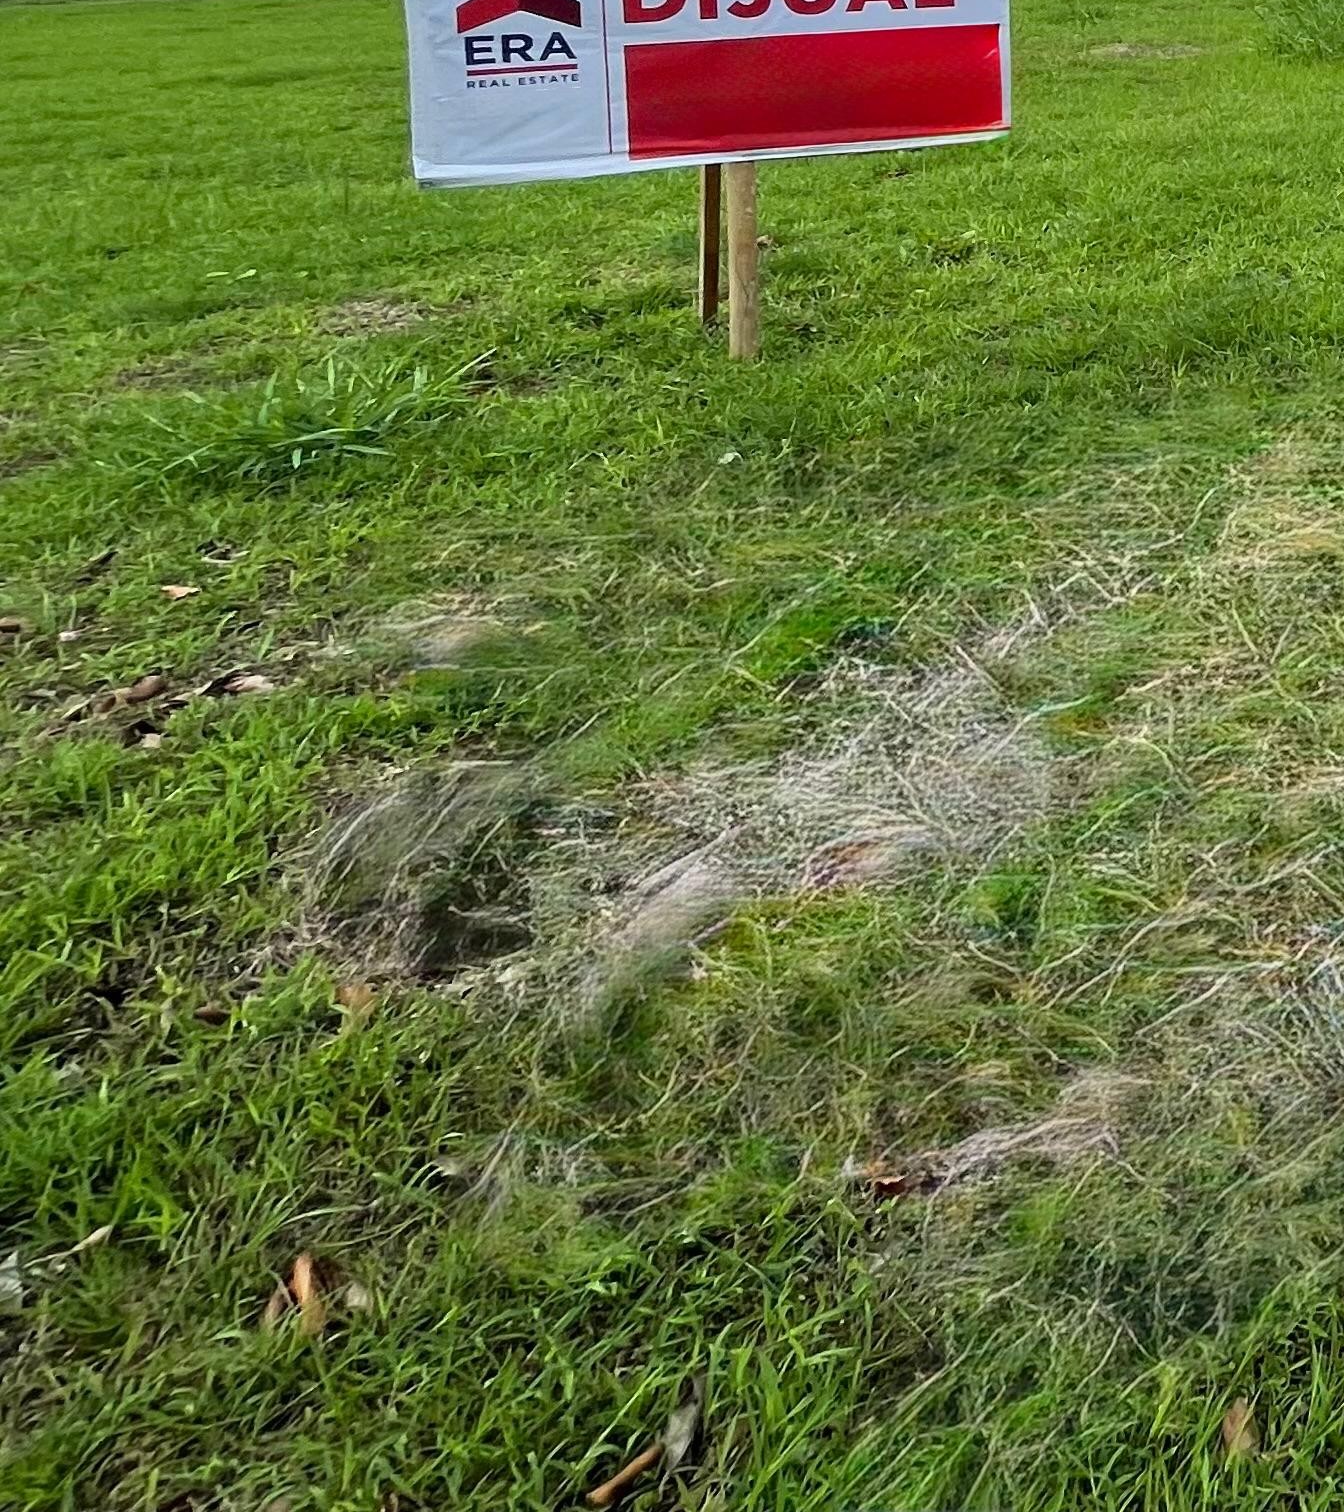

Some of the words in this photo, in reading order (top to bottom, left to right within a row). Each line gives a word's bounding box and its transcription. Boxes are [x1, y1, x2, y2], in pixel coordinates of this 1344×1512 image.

[464, 31, 578, 66] ERA
[466, 78, 511, 89] REAL
[518, 73, 579, 86] ESTATE
